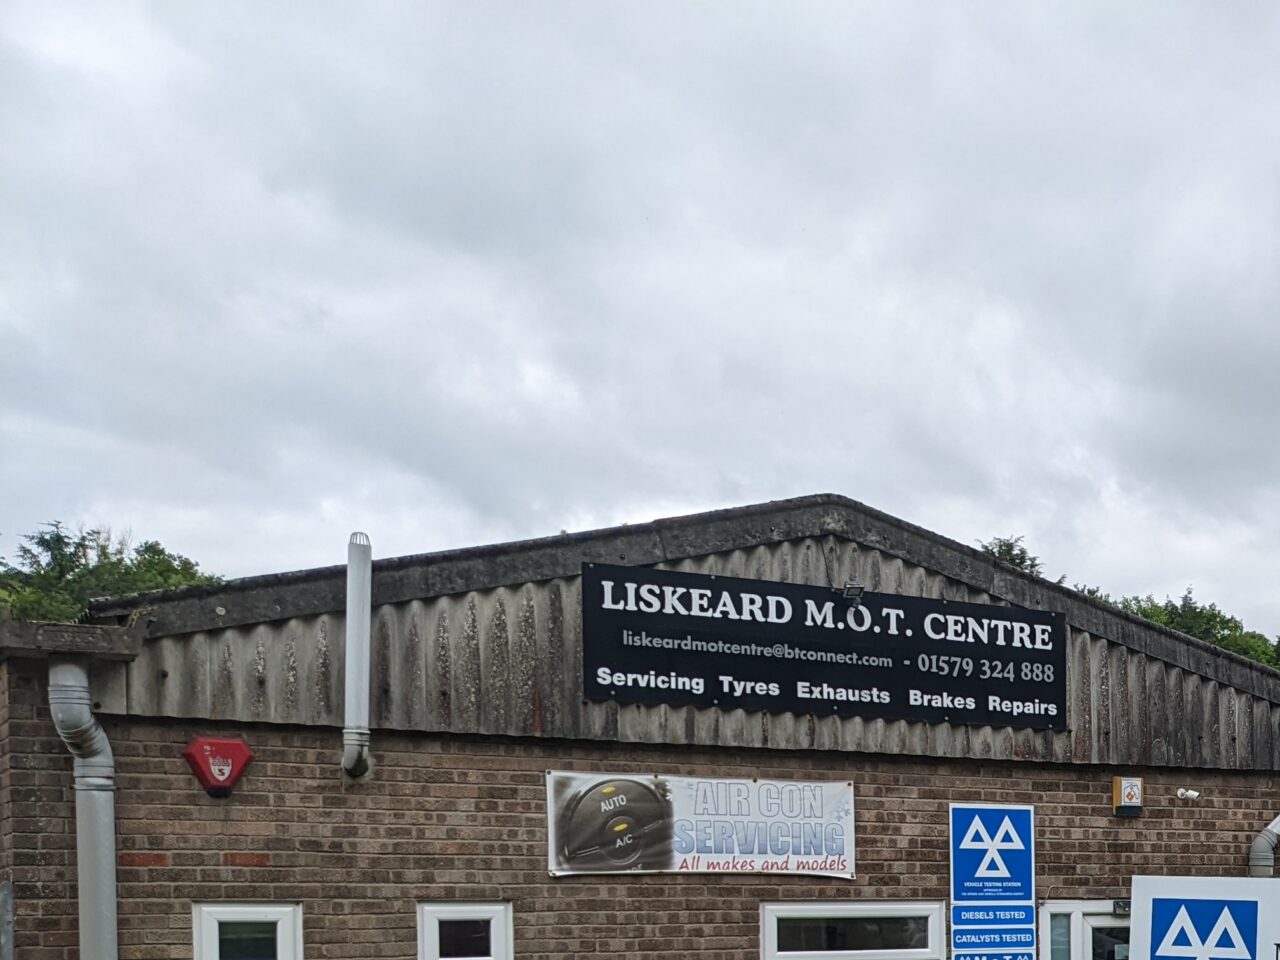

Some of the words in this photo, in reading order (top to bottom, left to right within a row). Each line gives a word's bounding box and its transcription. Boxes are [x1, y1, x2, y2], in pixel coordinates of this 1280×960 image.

[600, 580, 793, 624] LISKEARD
[804, 599, 913, 637] M.O.T.
[923, 612, 1054, 650] CENTRE
[622, 629, 893, 668] liskeardmotcentre@btconnect.com
[917, 653, 974, 678] 01579
[979, 659, 1016, 682] 324
[1020, 661, 1055, 683] 888
[596, 667, 705, 695] Servicing
[719, 675, 780, 697] Tyres
[796, 681, 891, 704] Exhausts
[909, 689, 976, 710] Brakes
[988, 695, 1058, 716] Repairs
[600, 795, 627, 813] AUTO
[694, 781, 750, 817] AIR
[757, 783, 824, 819] CON
[615, 834, 633, 848] A/C
[673, 819, 845, 856] SERVICING
[679, 855, 700, 871] All
[707, 855, 755, 872] makes
[761, 855, 790, 872] and
[796, 855, 847, 873] models
[961, 911, 995, 920] DIESELS
[995, 911, 1026, 919] TESTED
[955, 934, 1000, 943] CATALYSTS
[1002, 934, 1032, 942] TESTED
